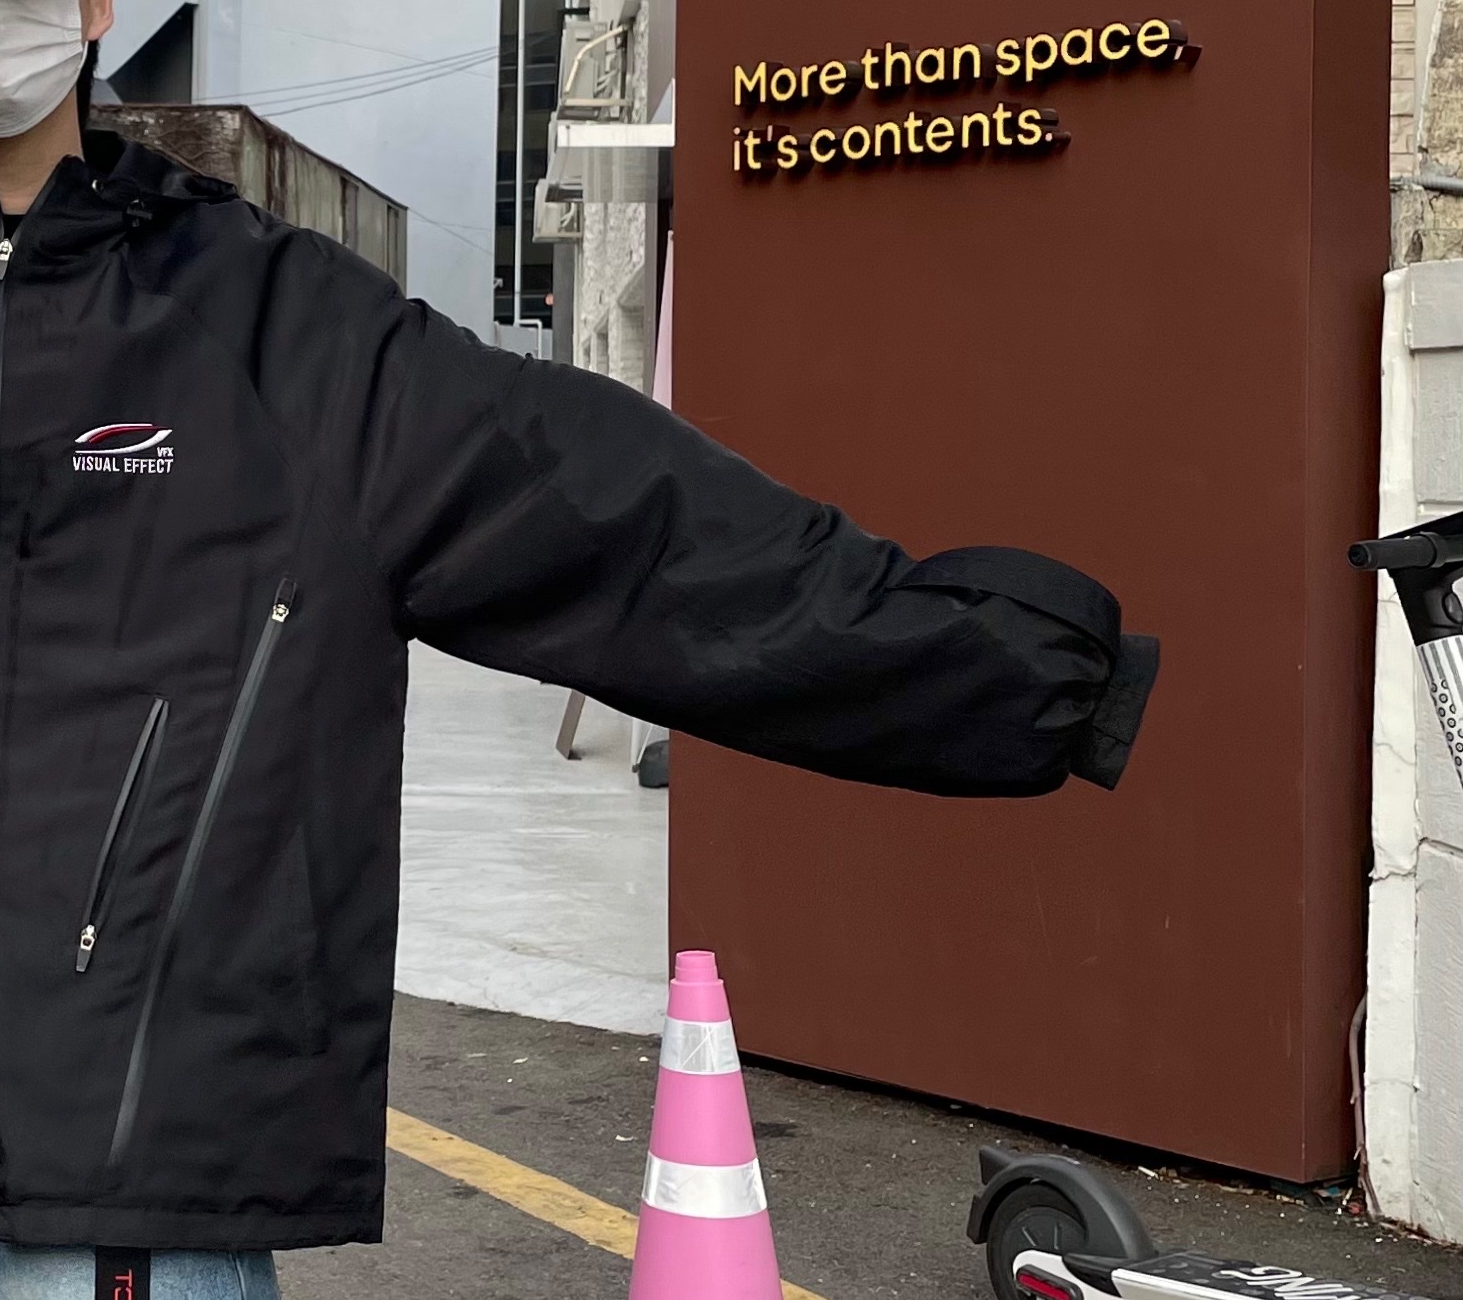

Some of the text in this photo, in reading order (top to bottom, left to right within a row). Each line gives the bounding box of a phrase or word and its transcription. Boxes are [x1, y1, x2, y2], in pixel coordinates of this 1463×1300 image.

[733, 18, 1187, 106] More than space,
[733, 102, 1055, 171] it's contents.
[73, 456, 174, 473] VISUAL EFFECT
